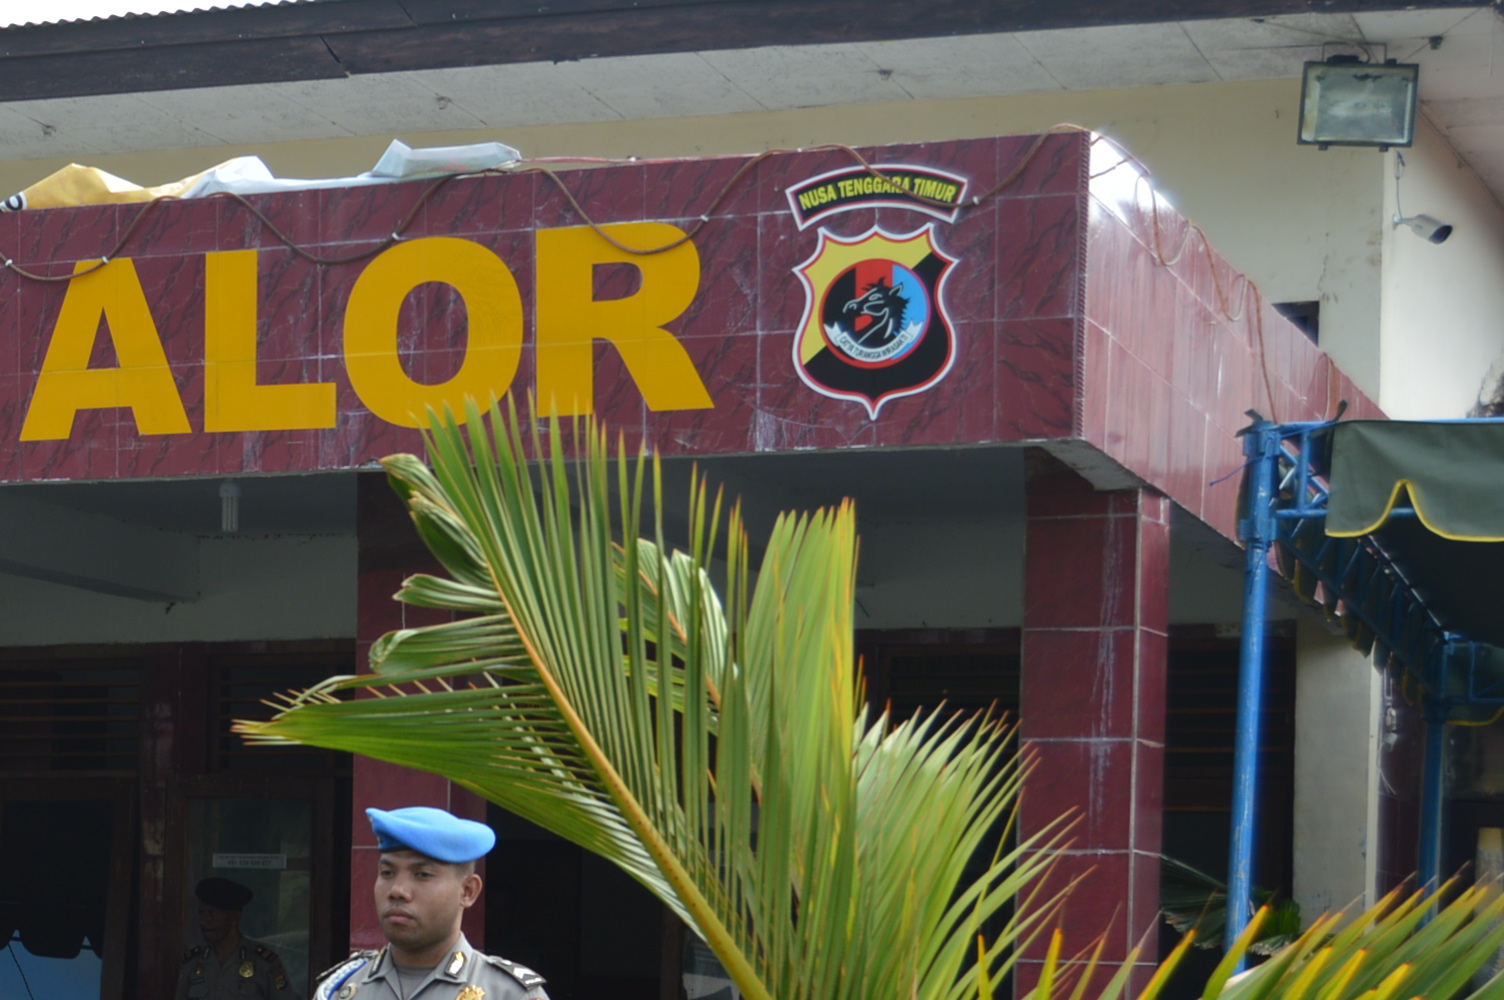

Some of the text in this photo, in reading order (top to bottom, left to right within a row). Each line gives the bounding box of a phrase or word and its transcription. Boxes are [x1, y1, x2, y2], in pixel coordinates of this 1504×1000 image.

[799, 176, 957, 210] NUSA TENGGARA TIMUR
[19, 221, 715, 441] ALOR
